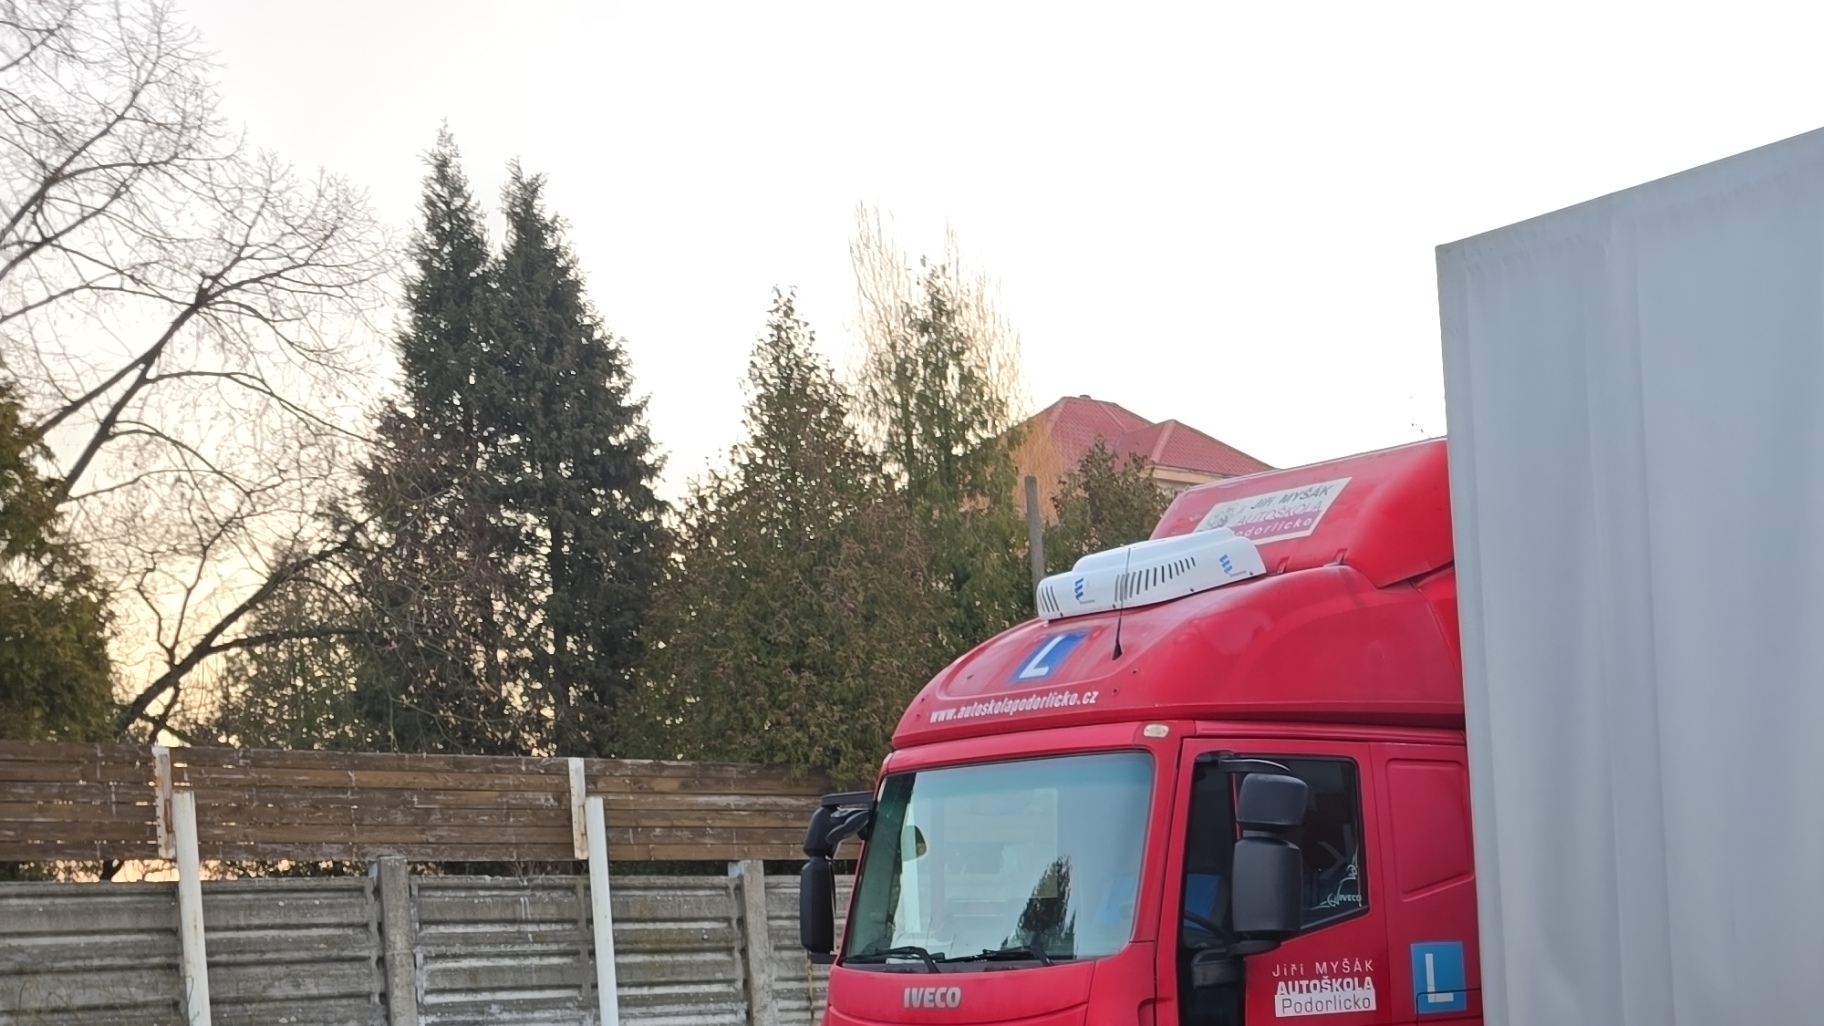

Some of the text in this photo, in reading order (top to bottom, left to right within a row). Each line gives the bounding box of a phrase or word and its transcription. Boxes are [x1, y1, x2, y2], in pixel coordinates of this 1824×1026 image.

[1232, 516, 1313, 537] odorlicko
[1018, 634, 1068, 679] L
[929, 690, 1099, 724] www.autoskolapodorlicko.cz
[1315, 957, 1374, 974] MYŠÁK
[1277, 975, 1374, 995] AUTOŠKOLA
[1425, 953, 1454, 1003] L
[903, 986, 962, 1009] IVECO
[1282, 994, 1371, 1014] Podorlicko
